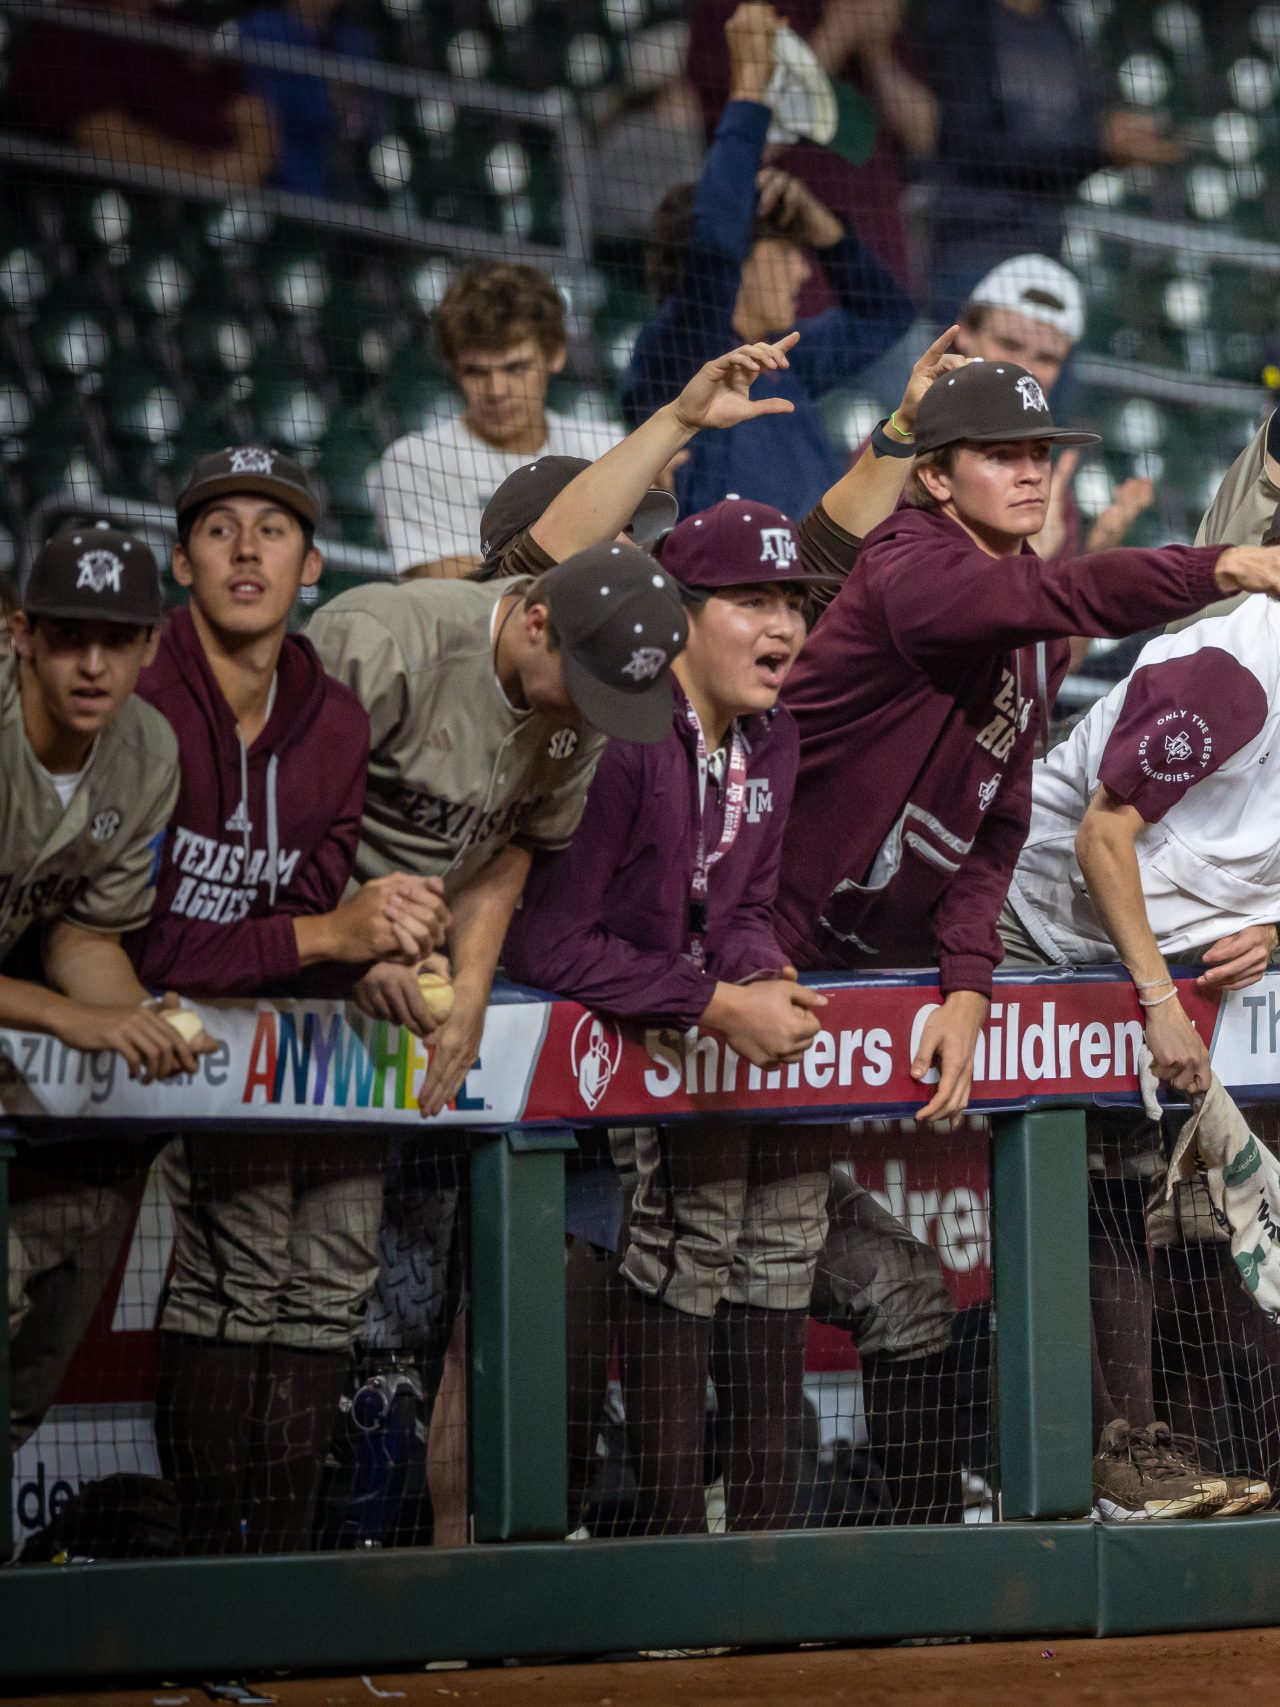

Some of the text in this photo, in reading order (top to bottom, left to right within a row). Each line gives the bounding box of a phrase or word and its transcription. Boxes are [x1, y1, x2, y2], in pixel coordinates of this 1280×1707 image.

[1138, 735, 1150, 756] FOR
[1151, 771, 1191, 782] AGGIES
[1157, 710, 1212, 768] ONLY THE BEST
[242, 1011, 485, 1111] ANYWHEE
